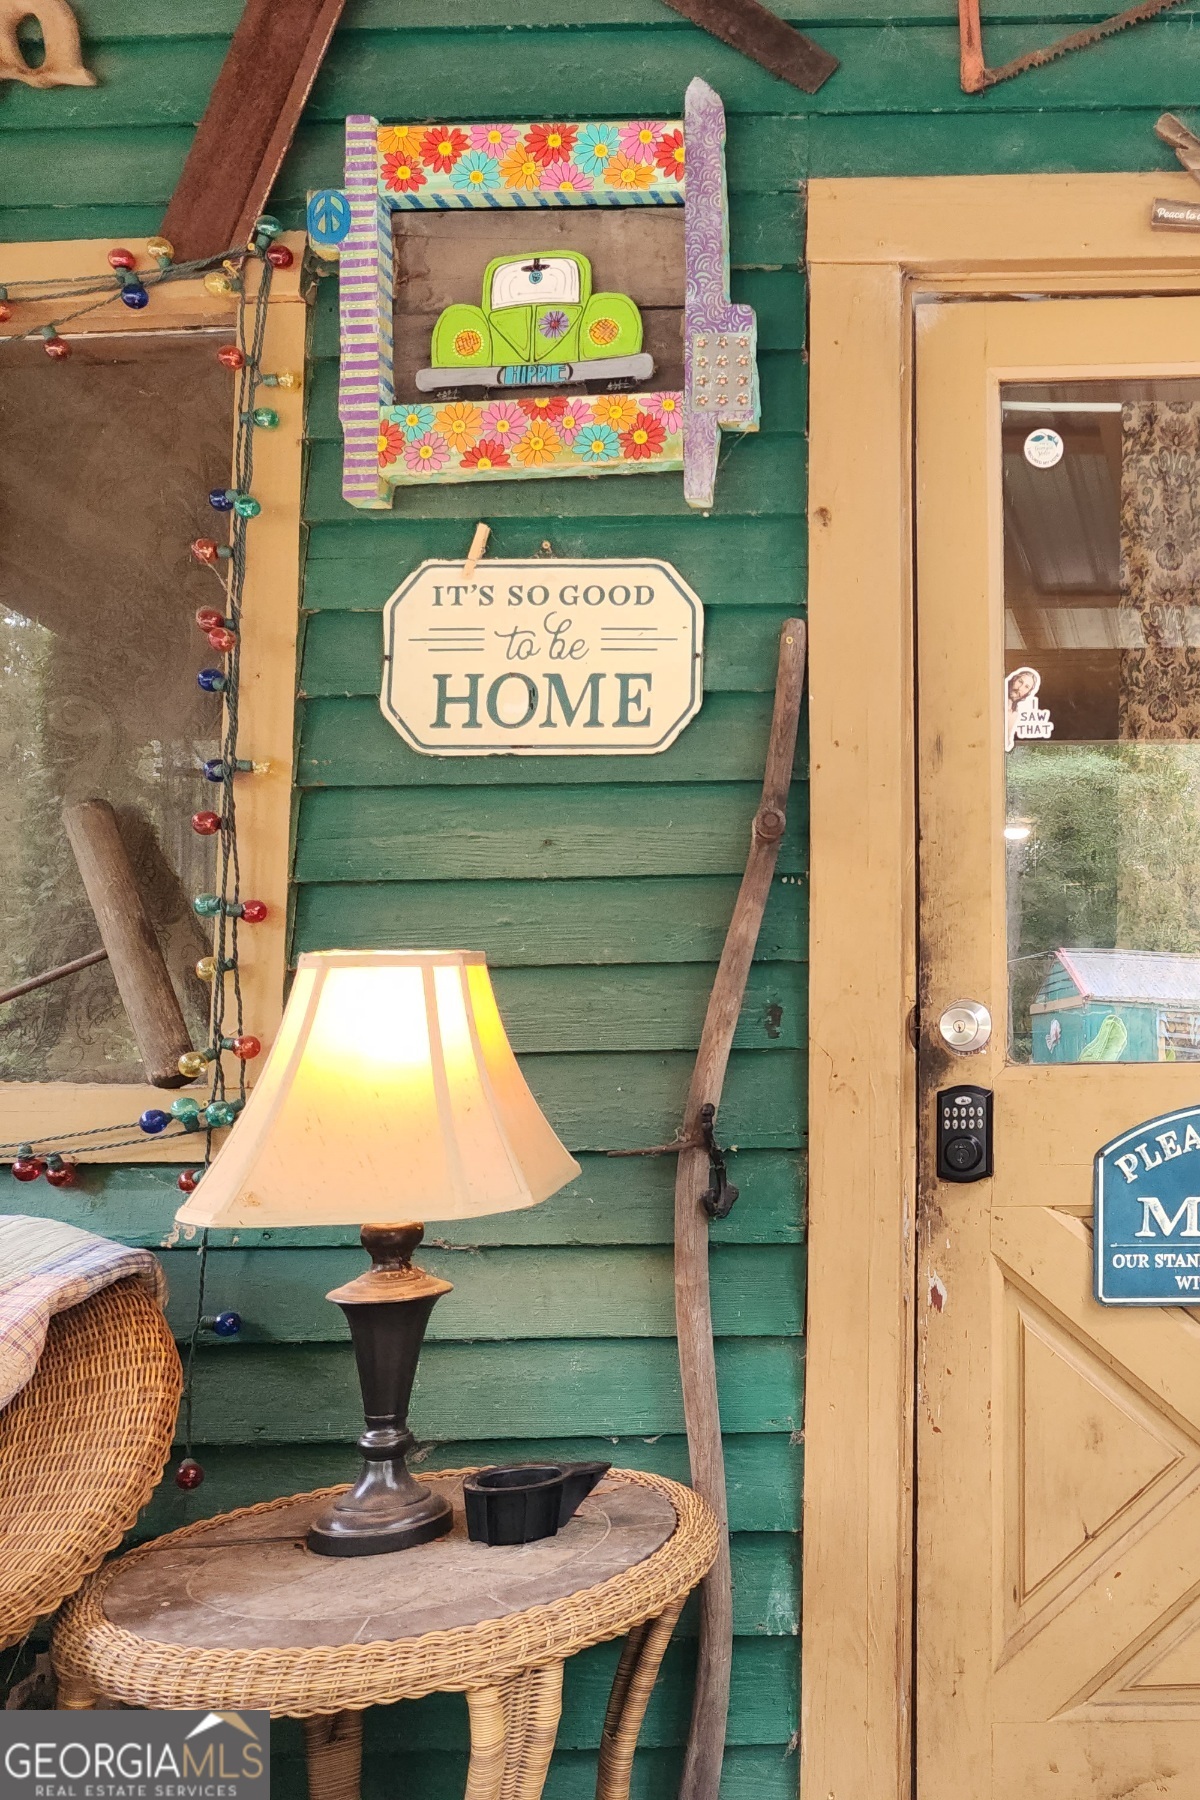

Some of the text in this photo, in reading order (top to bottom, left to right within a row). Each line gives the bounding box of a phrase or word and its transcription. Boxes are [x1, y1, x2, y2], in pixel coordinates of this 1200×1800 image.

[1157, 207, 1185, 219] Peace
[1185, 209, 1196, 220] to
[503, 363, 568, 385] HIPPIE
[431, 585, 656, 607] IT'S SO GOOD
[494, 611, 590, 661] to be
[429, 672, 653, 730] HOME
[1032, 699, 1036, 710] I
[1020, 712, 1046, 721] SAW
[1017, 725, 1050, 735] THAT
[1111, 1253, 1150, 1269] OUR
